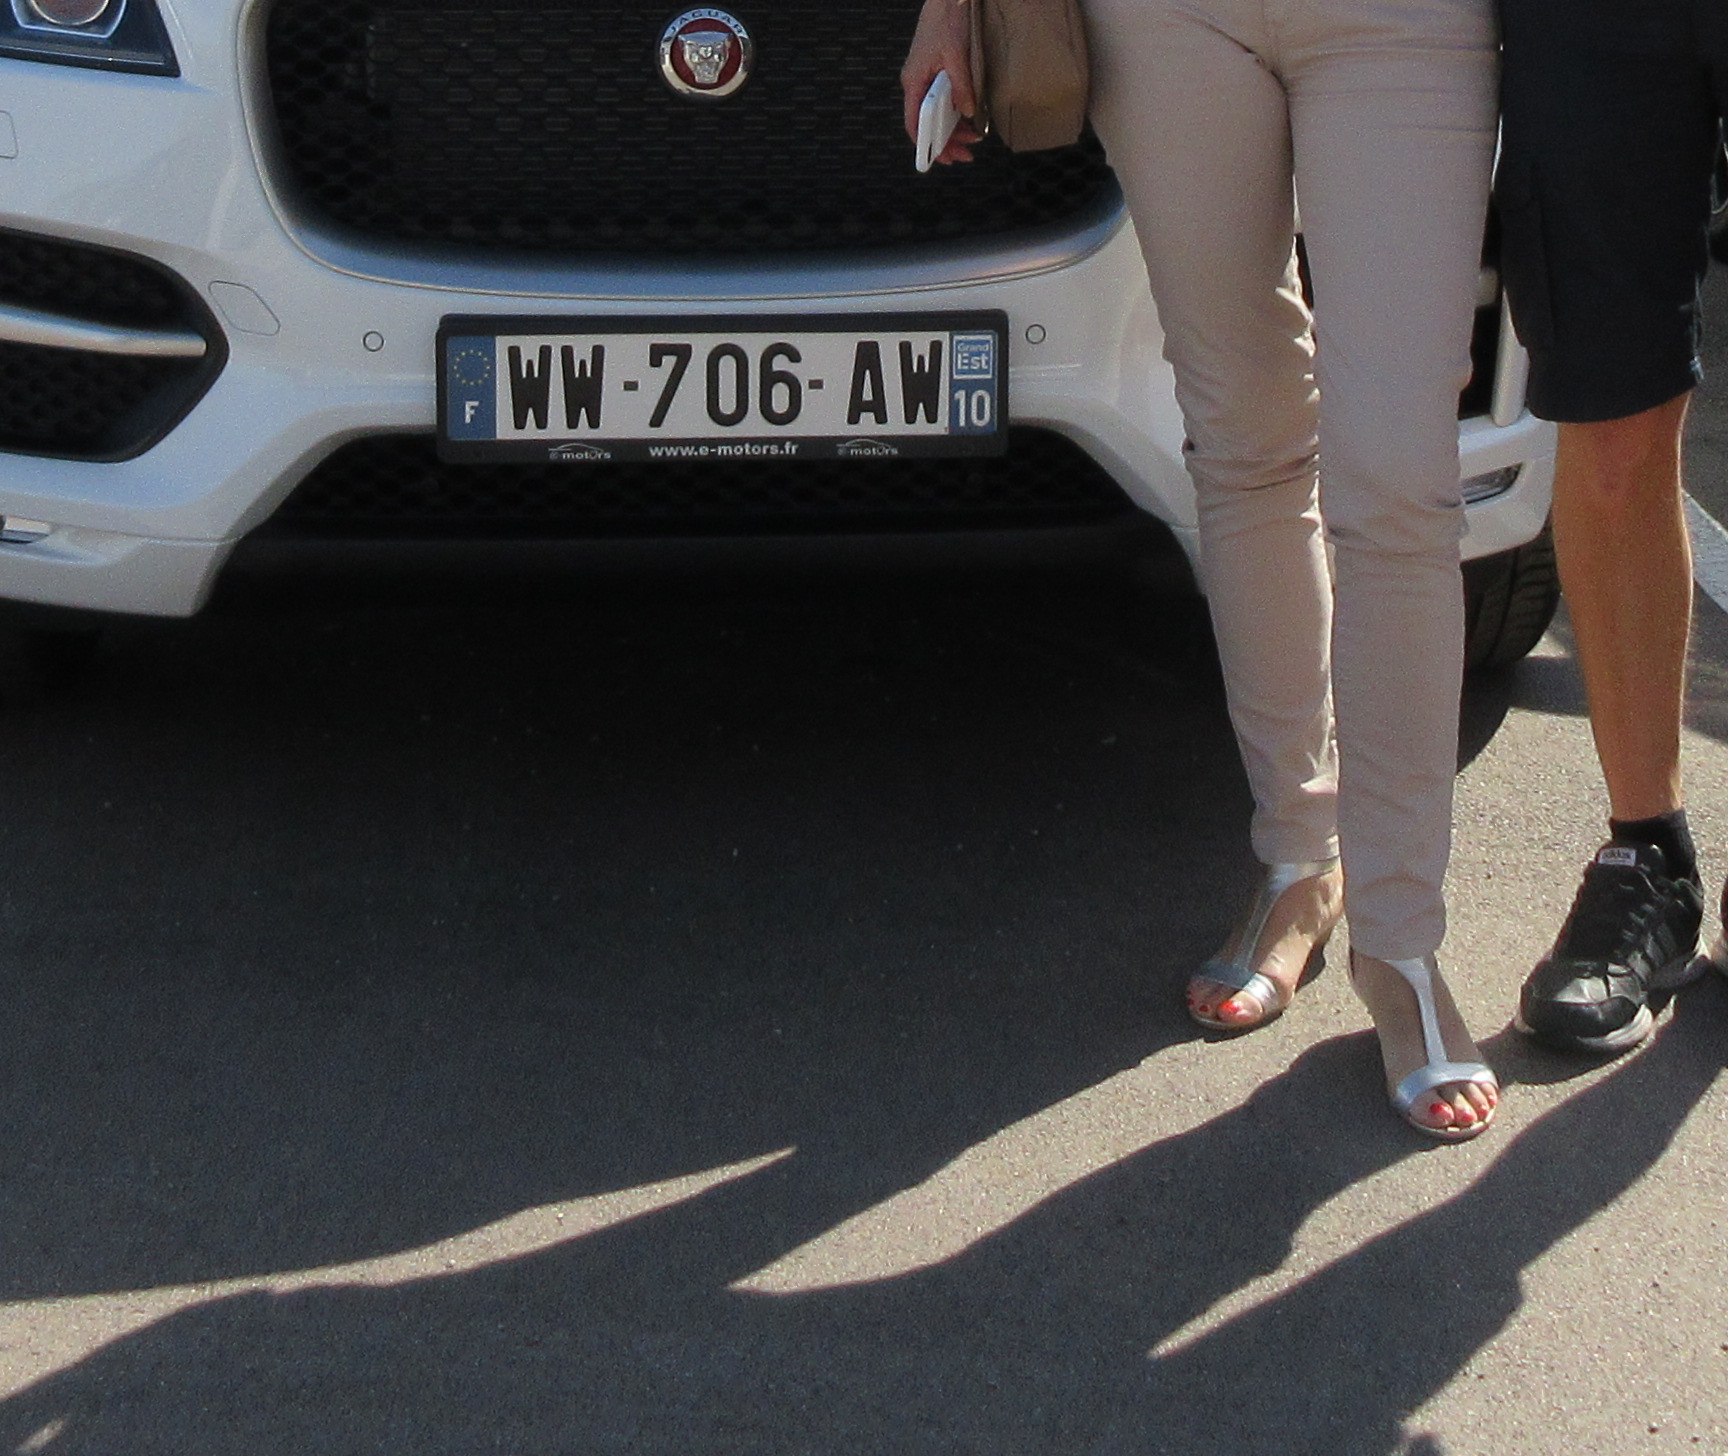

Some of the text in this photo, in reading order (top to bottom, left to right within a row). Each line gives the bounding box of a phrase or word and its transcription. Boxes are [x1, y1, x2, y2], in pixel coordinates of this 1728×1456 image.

[668, 9, 744, 35] JAGUAR
[957, 342, 990, 353] Grand
[957, 352, 989, 370] Est
[463, 401, 480, 424] F
[954, 390, 991, 429] 10
[649, 442, 800, 458] www.e-motors.fr
